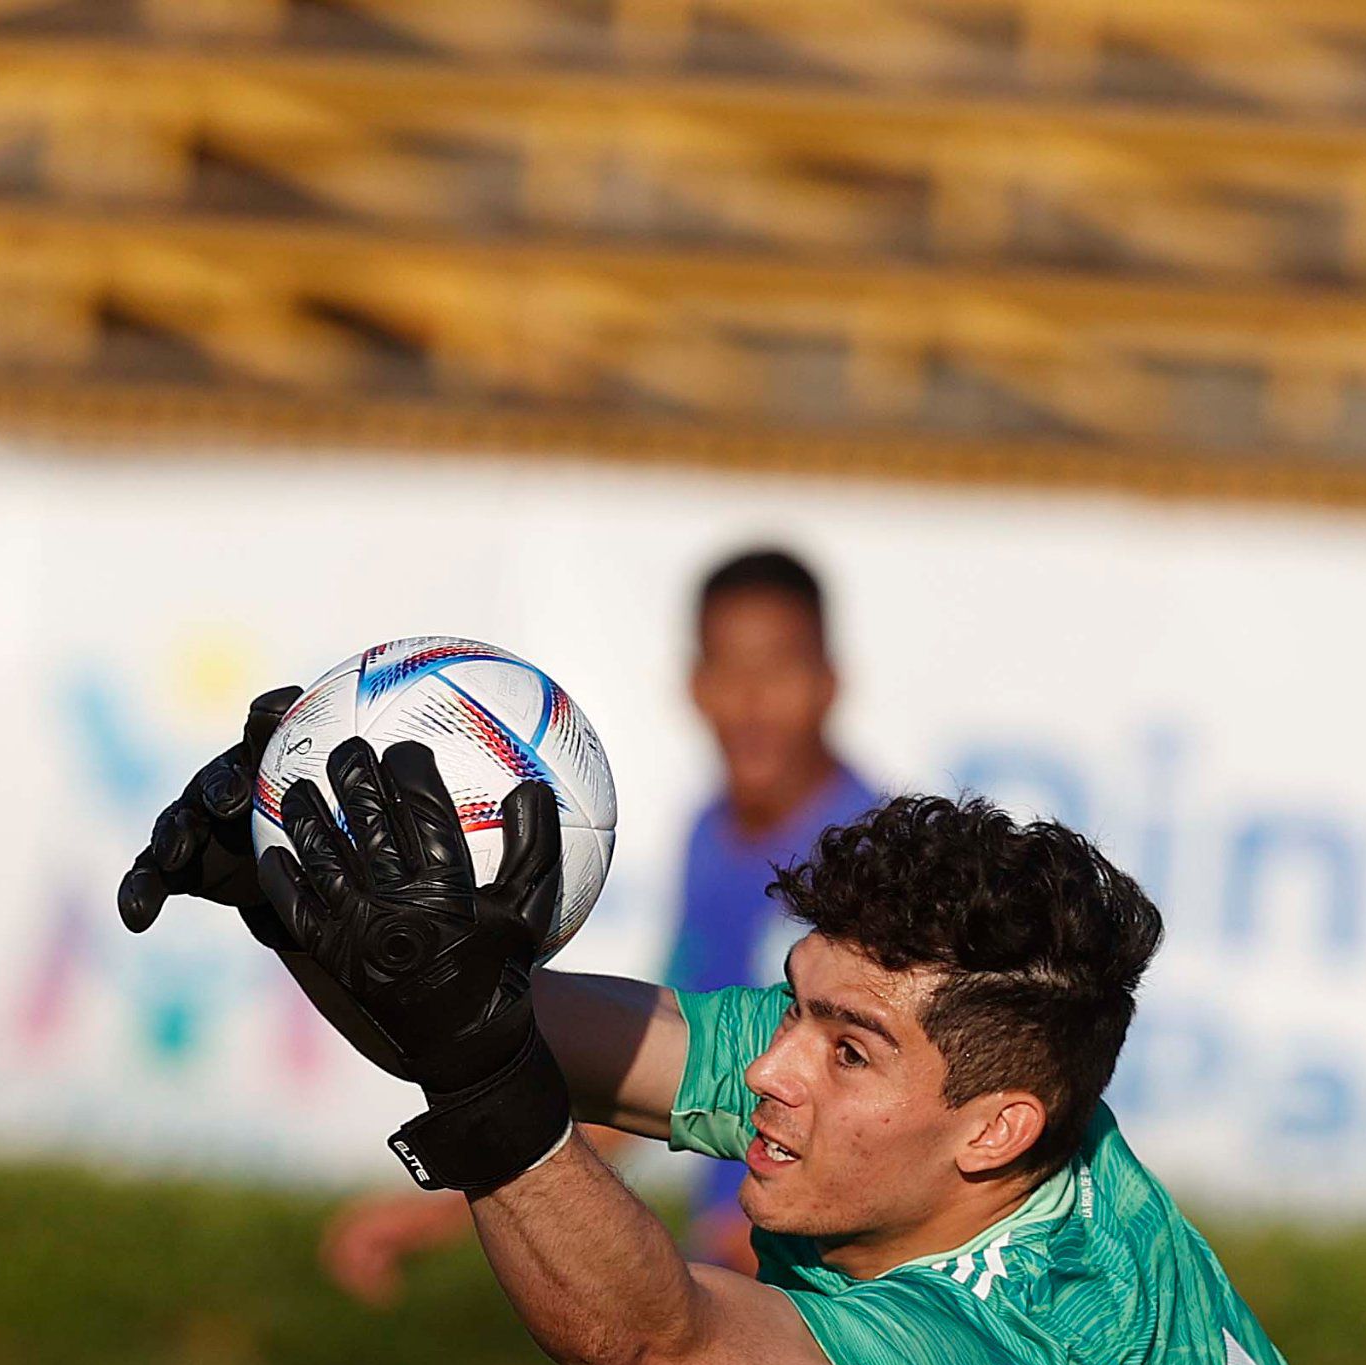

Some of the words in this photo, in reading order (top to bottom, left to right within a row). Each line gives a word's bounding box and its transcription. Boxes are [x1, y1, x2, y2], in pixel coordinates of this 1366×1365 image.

[393, 1140, 431, 1182] ELITE
[1080, 1187, 1094, 1207] ROJA
[1081, 1207, 1093, 1219] LA
